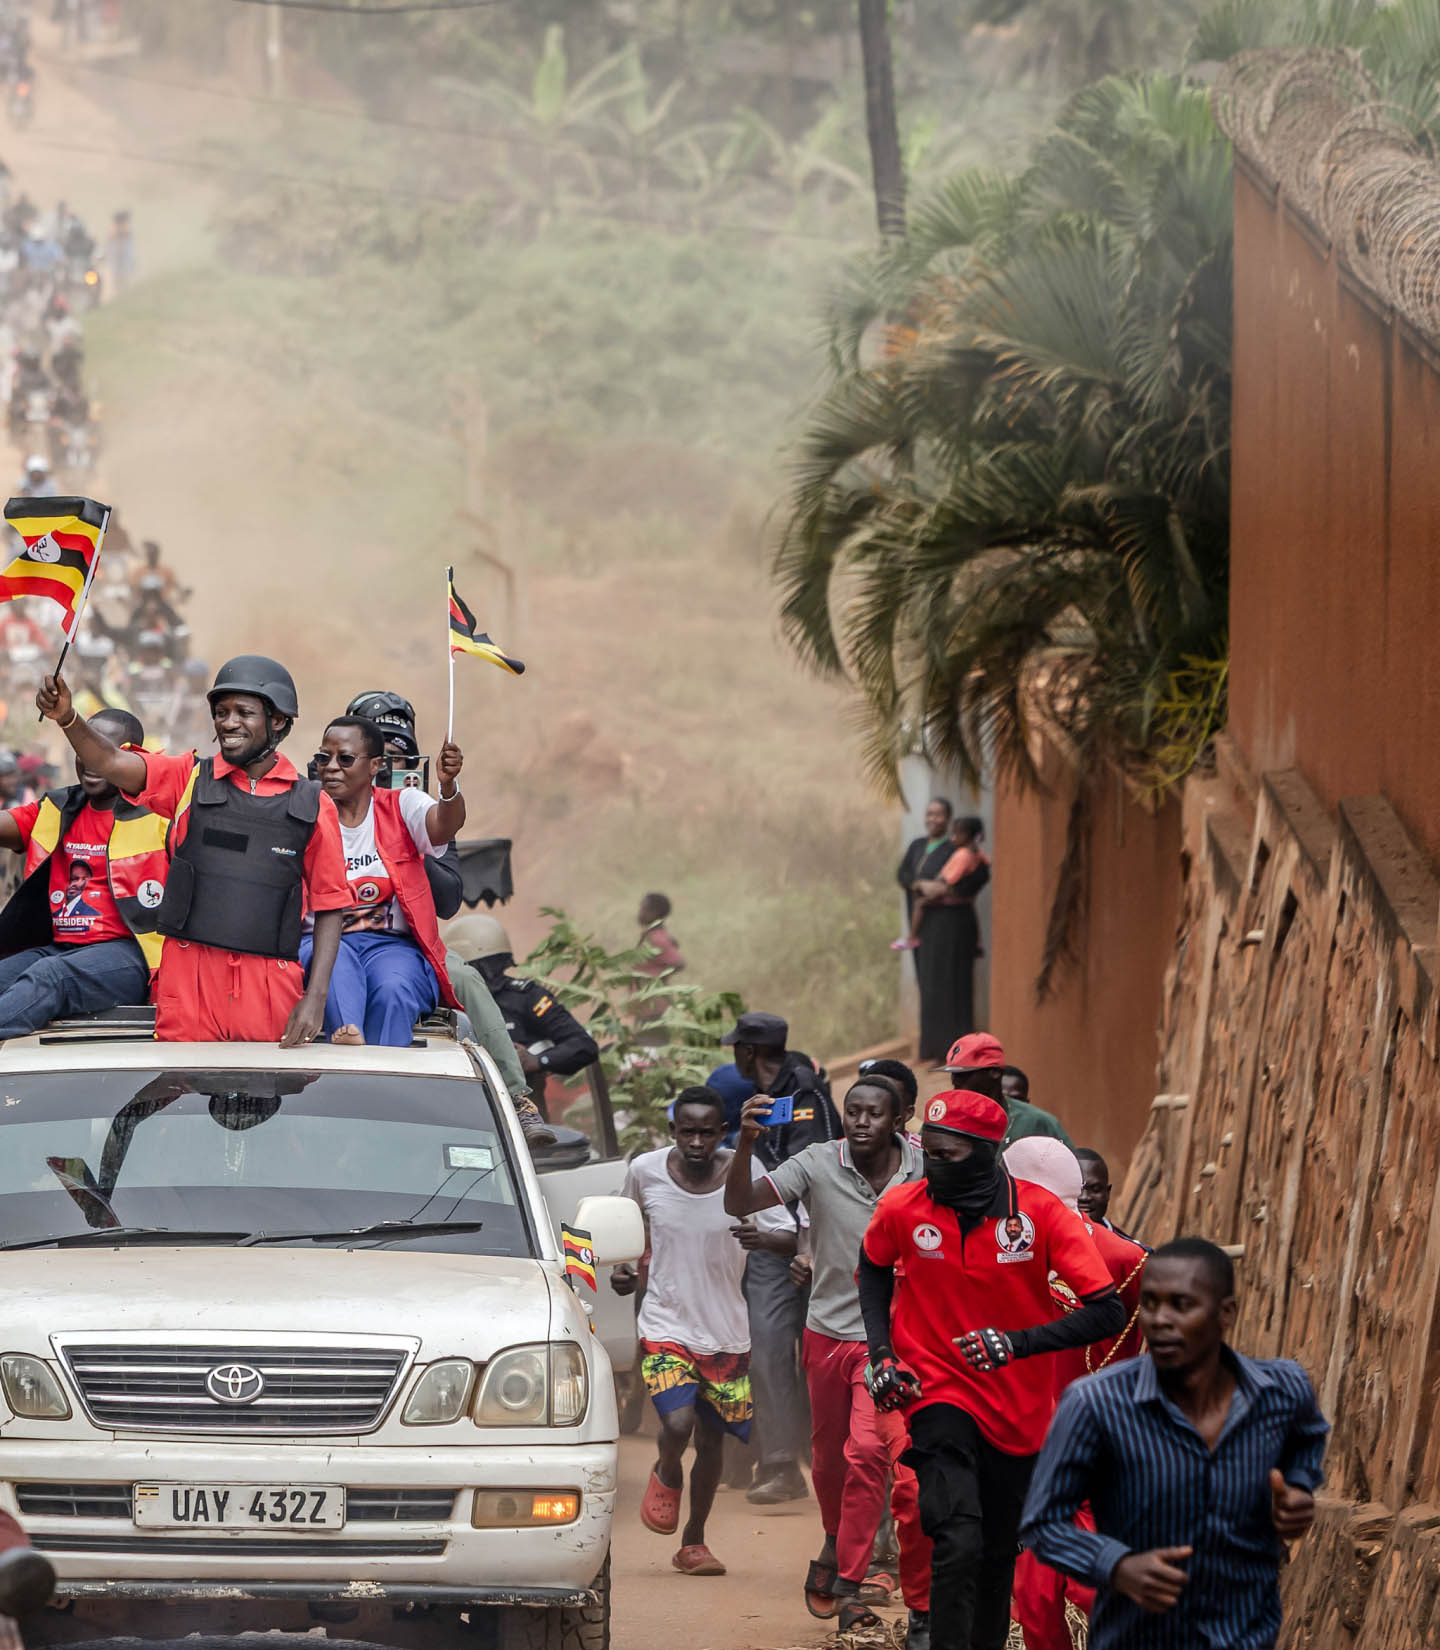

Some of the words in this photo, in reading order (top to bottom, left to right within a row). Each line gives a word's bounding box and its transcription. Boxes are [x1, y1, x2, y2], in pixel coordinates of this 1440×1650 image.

[375, 714, 407, 729] RESS
[347, 853, 379, 871] ESIDE
[172, 1489, 230, 1522] UAY
[248, 1490, 327, 1524] 432Z
